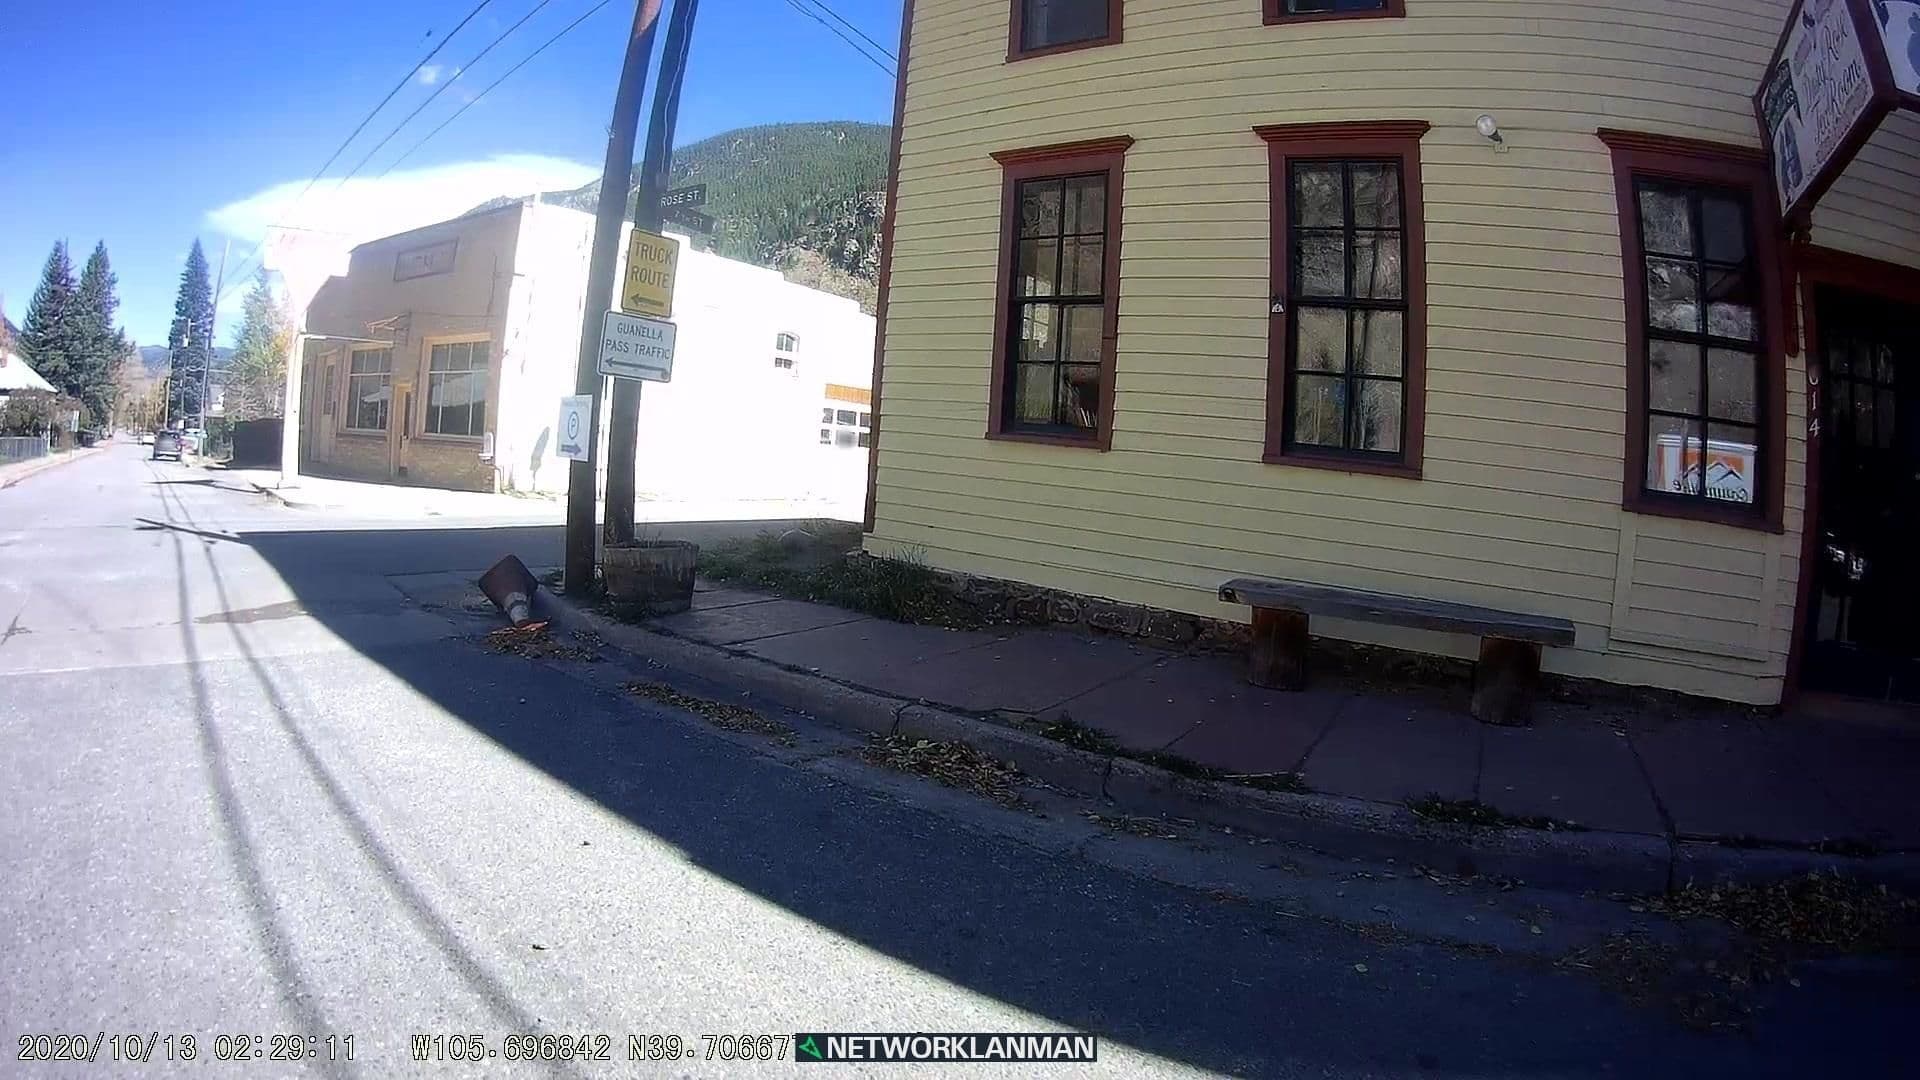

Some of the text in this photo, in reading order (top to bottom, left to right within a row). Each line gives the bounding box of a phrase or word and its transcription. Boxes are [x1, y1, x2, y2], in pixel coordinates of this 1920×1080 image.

[660, 193, 685, 208] ROSE
[635, 241, 673, 265] TRUCK
[631, 265, 671, 289] ROUTE
[617, 322, 663, 342] GUANELLA
[606, 338, 671, 361] PASS TRAFFIC
